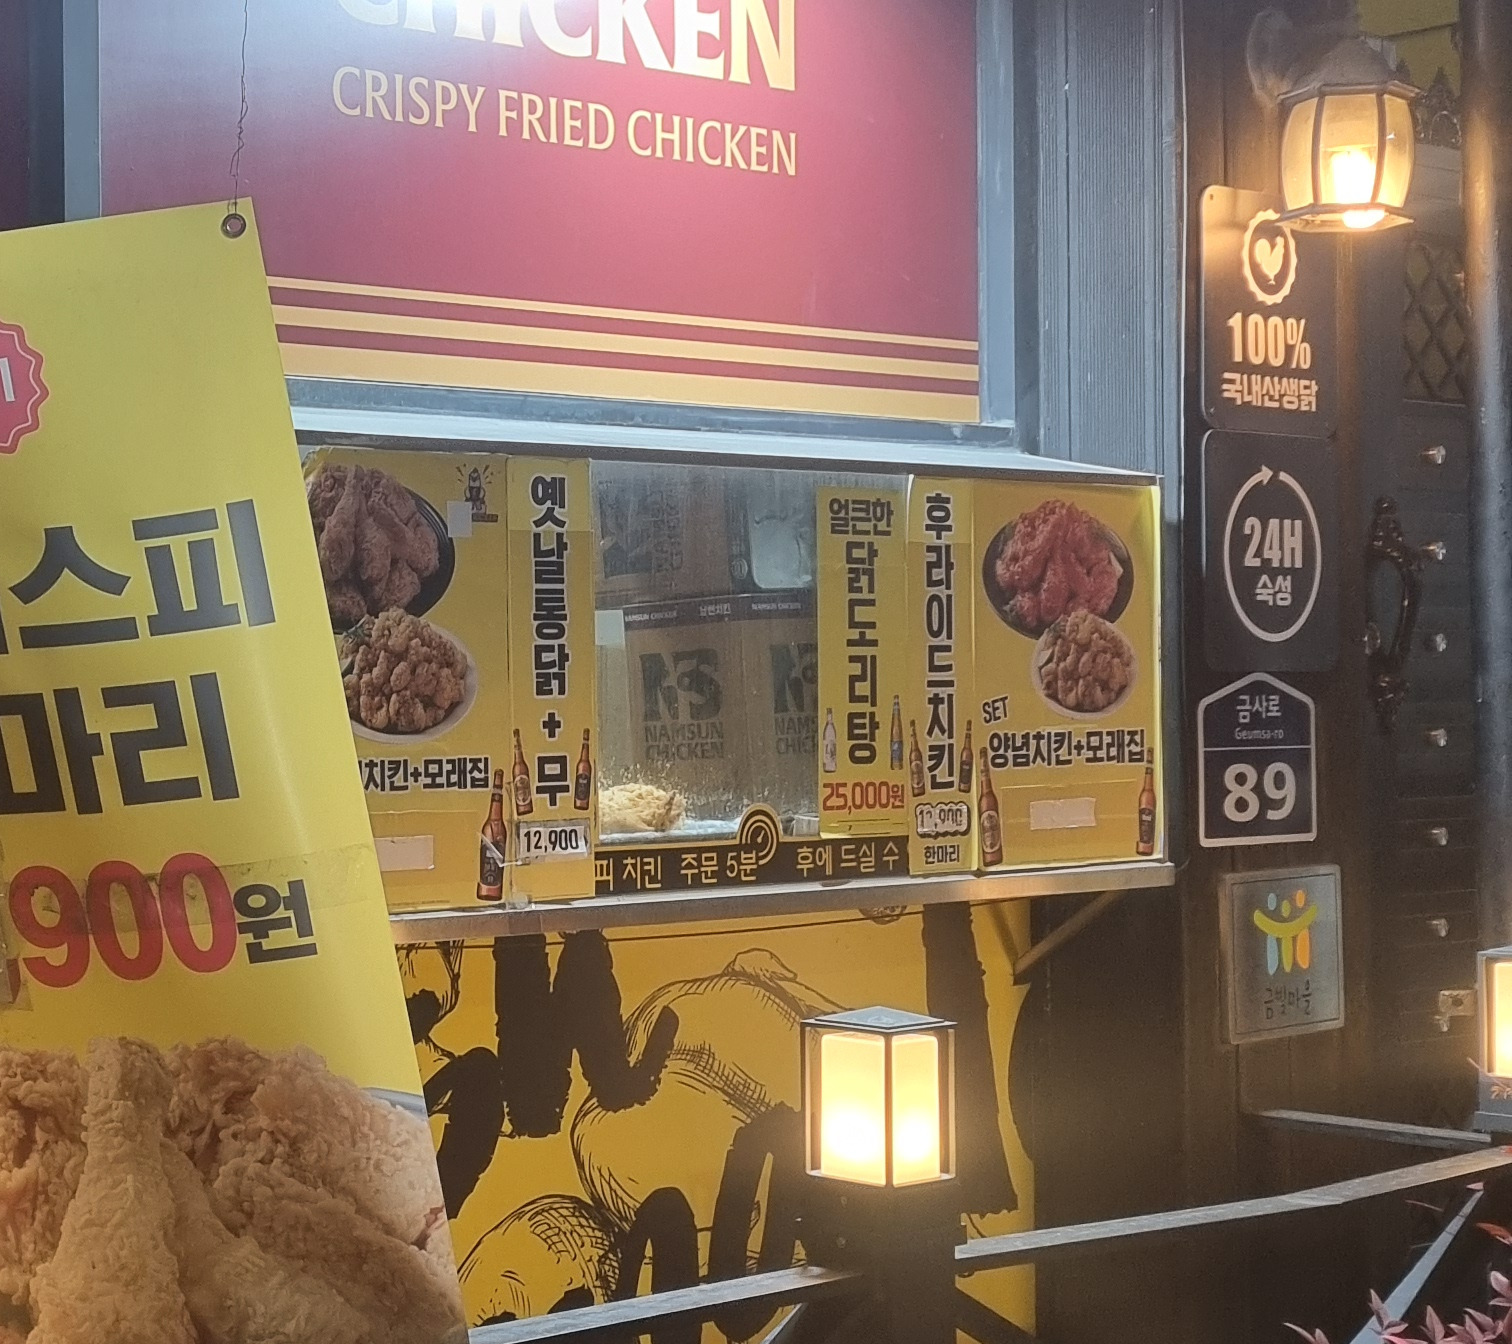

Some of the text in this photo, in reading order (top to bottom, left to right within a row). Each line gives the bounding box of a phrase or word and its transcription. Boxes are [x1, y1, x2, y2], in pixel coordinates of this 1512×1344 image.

[331, 65, 798, 177] CRISPY FRIED CHICKEN
[1226, 311, 1312, 370] 100%
[1221, 371, 1319, 412] 국내산생닭
[828, 496, 895, 537] 얼큰한
[1243, 516, 1304, 569] 24H
[530, 475, 571, 697] 옛날통닭
[1254, 574, 1292, 607] 숙성
[845, 540, 880, 766] 닭도리탕
[924, 492, 955, 791] 후라이드치킨
[982, 696, 1009, 724] SET
[1236, 694, 1282, 723] 금사로
[988, 728, 1146, 769] 양념치킨+모래집
[535, 754, 570, 807] 무
[822, 780, 906, 816] 25,000원
[1223, 761, 1297, 823] 89
[523, 827, 581, 854] 12,900
[923, 843, 961, 865] 한마리
[622, 855, 662, 889] 치킨
[680, 852, 719, 885] 주문
[725, 850, 758, 882] 5분
[796, 846, 833, 878] 후에
[840, 842, 876, 873] 드실
[883, 840, 899, 871] 수
